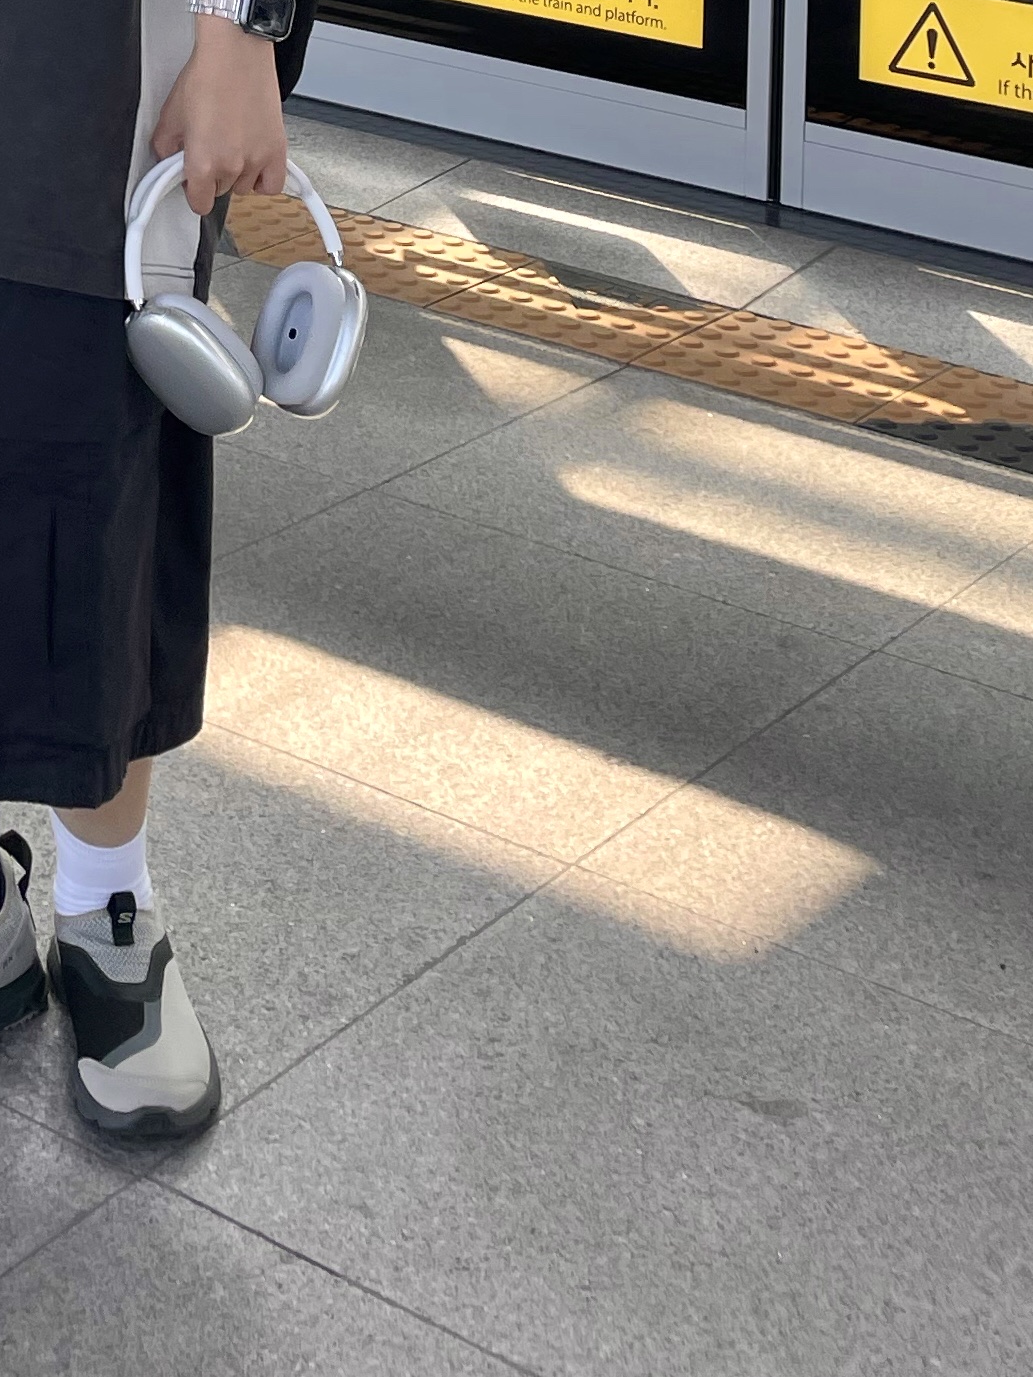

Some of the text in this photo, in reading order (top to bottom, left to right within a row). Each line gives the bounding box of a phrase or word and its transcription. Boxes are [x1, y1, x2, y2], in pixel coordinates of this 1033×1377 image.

[576, 3, 601, 18] and
[605, 6, 667, 30] platform.
[998, 79, 1011, 96] If
